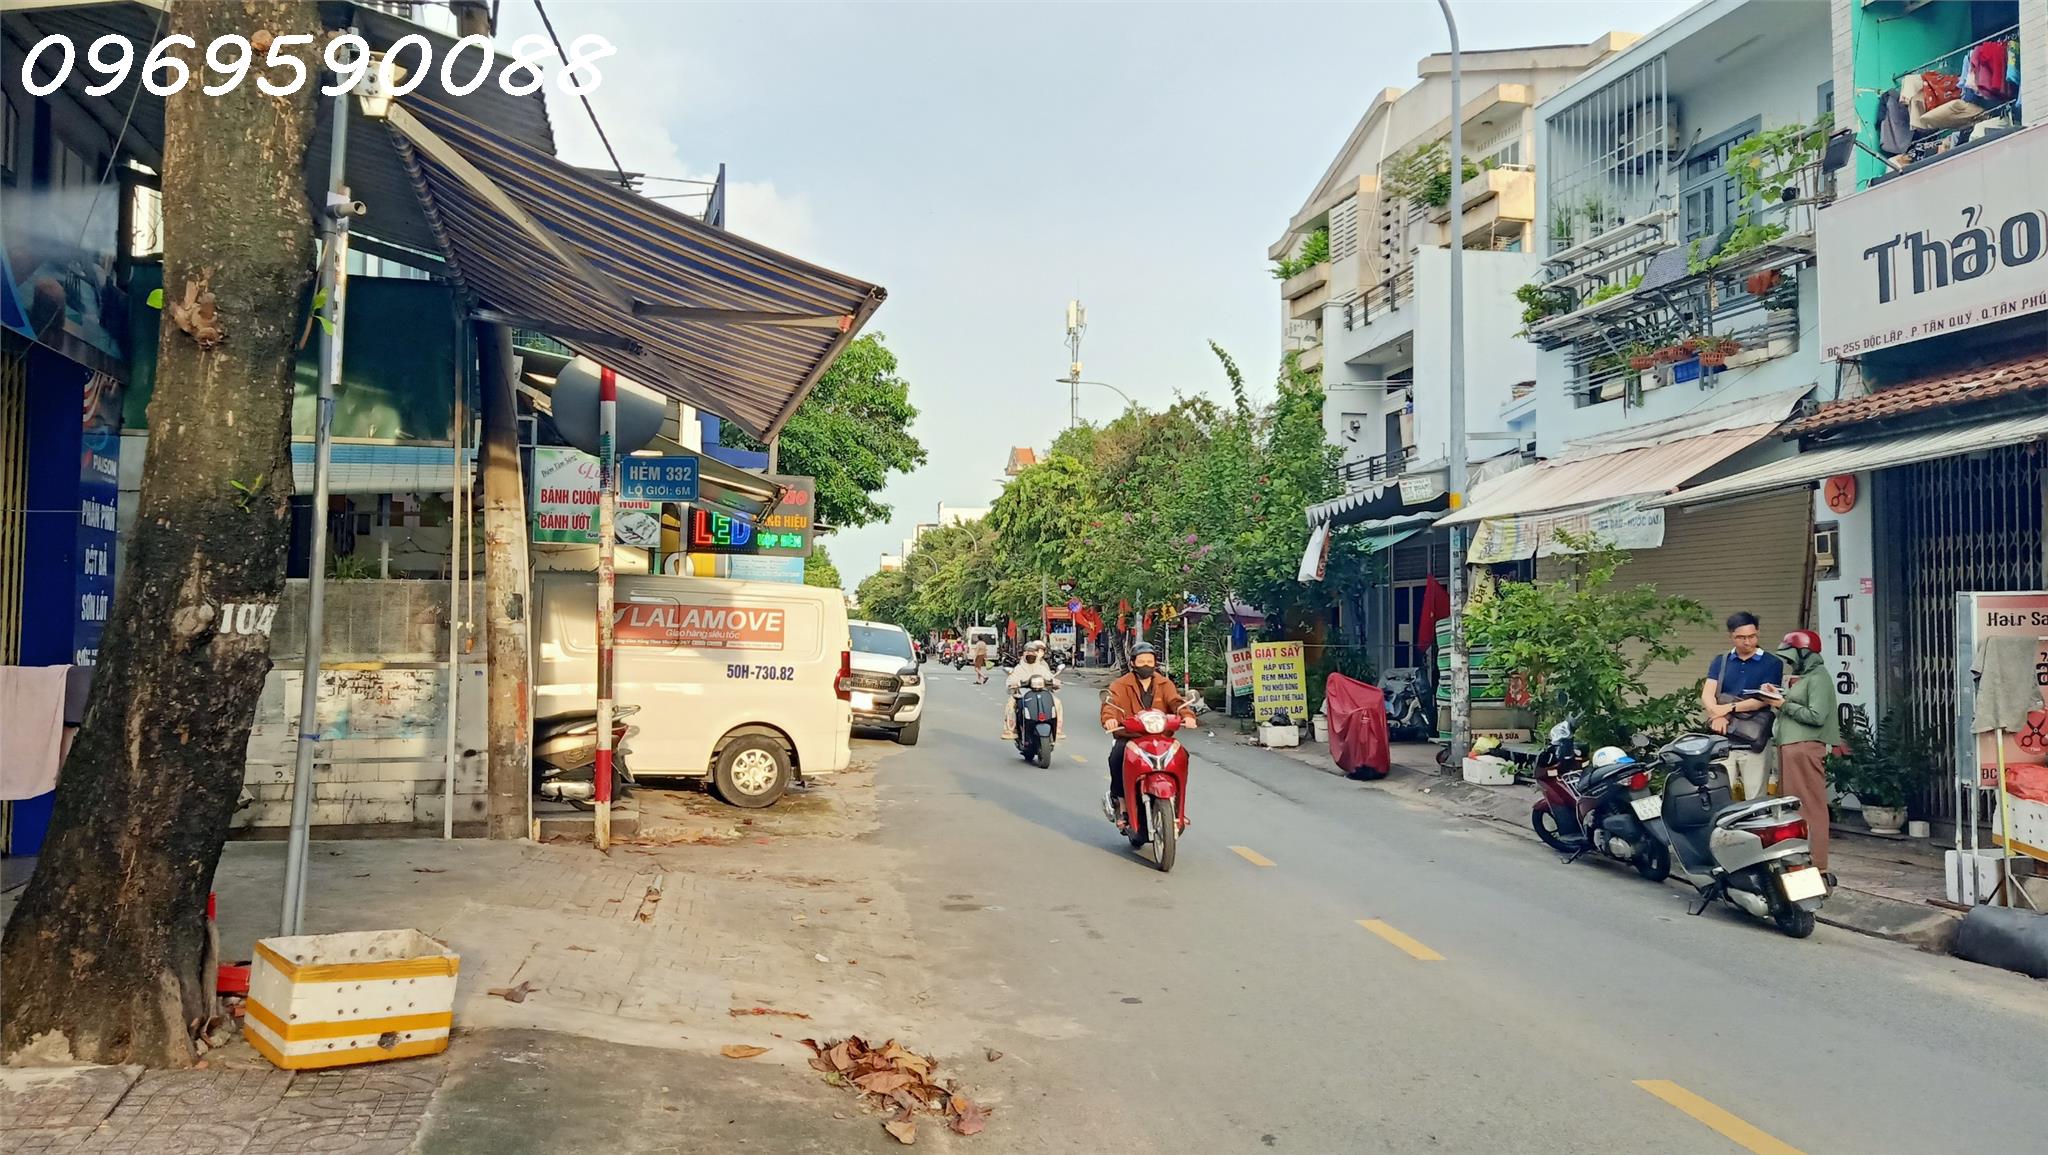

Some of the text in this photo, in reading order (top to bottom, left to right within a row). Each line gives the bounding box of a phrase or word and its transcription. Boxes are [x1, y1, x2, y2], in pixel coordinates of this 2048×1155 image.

[1863, 204, 2048, 304] Thảo
[1843, 341, 1861, 354] 255
[1863, 334, 1882, 348] ĐỘC
[1923, 319, 1945, 333] TÂN
[2021, 290, 2048, 310] PHÚ
[630, 462, 692, 482] HẺM 332
[541, 486, 569, 505] BÁNH
[572, 485, 601, 506] CUỐN
[676, 487, 691, 496] 6M
[540, 512, 592, 530] BÁNH ƯỚT
[695, 509, 750, 546] LED
[784, 514, 807, 531] HIỆU
[221, 603, 279, 638] 104
[630, 607, 783, 632] LALAMOVE
[1986, 611, 2026, 627] Hair
[1232, 651, 1252, 662] BIA
[1834, 594, 1859, 729] Thảo
[726, 664, 794, 681] 50H-730.82
[1260, 707, 1273, 716] 253
